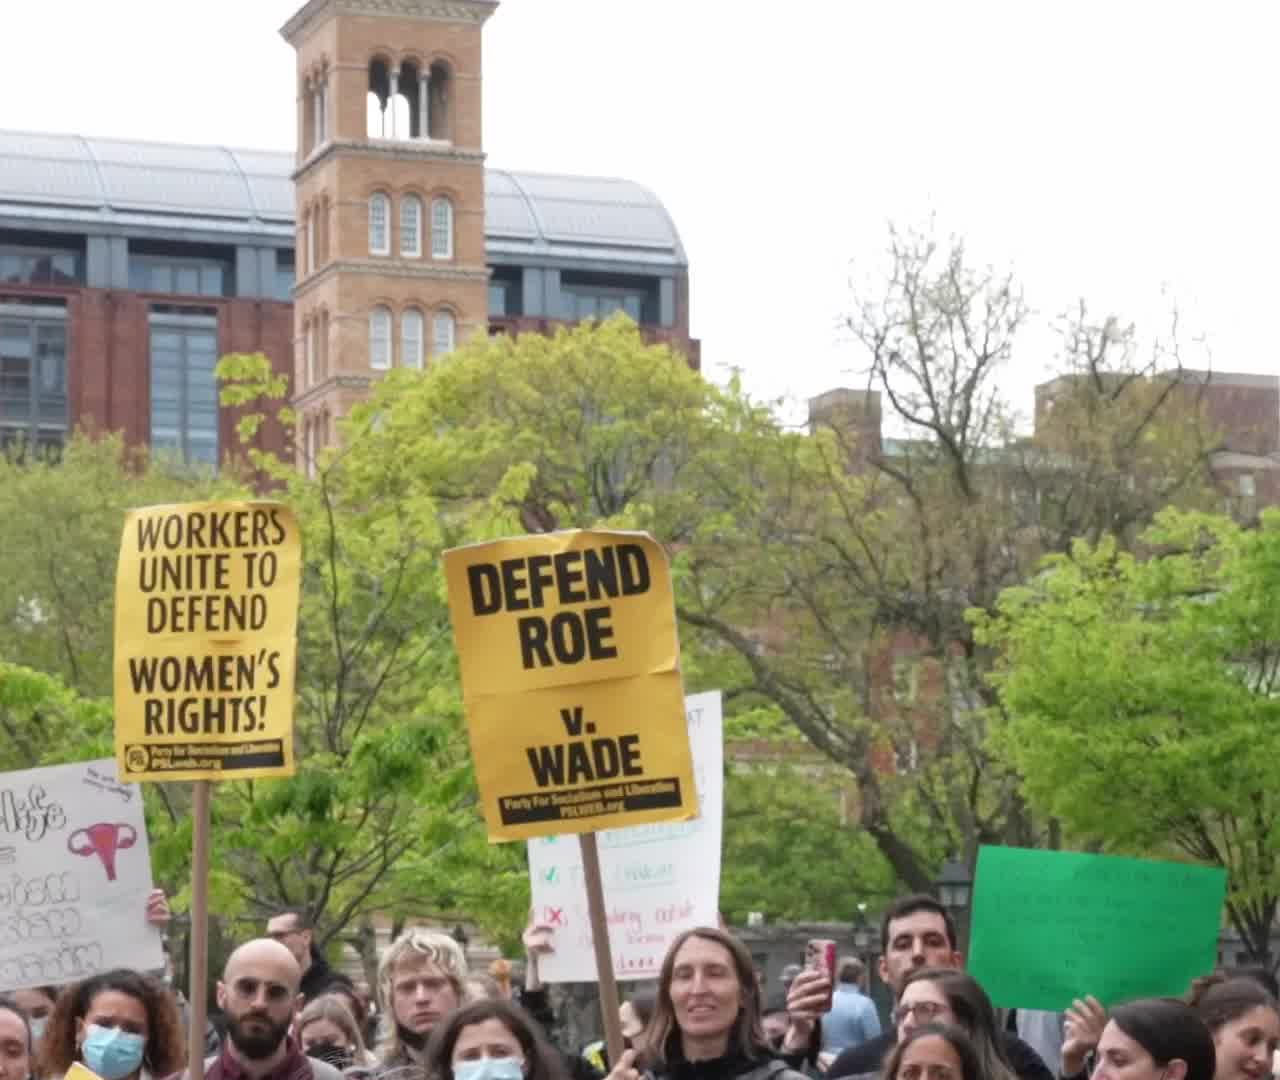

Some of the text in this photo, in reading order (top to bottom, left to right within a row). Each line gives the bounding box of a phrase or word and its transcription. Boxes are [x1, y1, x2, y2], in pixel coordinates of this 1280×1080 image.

[137, 510, 286, 552] WORKERS
[139, 551, 277, 592] UNITE TO
[467, 544, 651, 617] DEFEND
[147, 594, 267, 634] DEFEND
[517, 606, 618, 670] ROE
[128, 649, 281, 694] WOMEN'S
[145, 696, 267, 736] RIGHTS!
[526, 734, 643, 788] WADE
